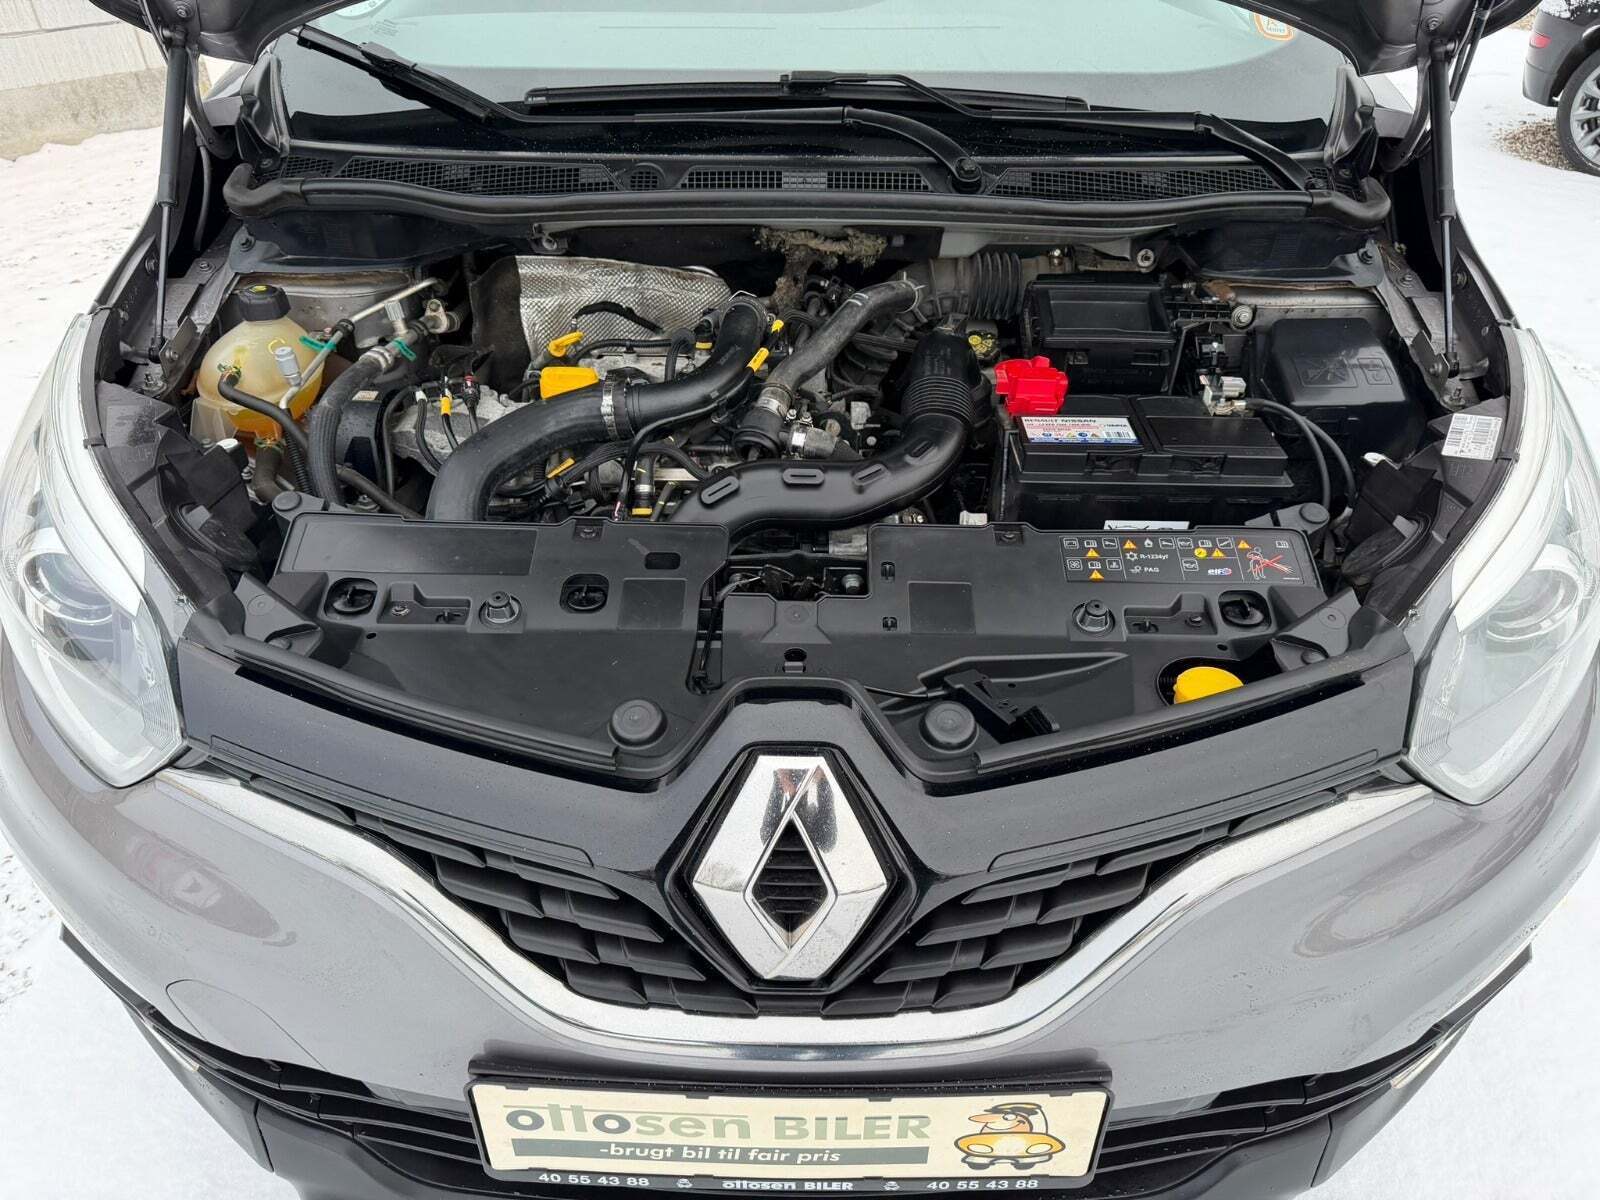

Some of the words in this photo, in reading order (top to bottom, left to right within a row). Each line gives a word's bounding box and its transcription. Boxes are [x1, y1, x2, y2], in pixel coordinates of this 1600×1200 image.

[774, 1115, 931, 1140] BILER
[600, 1143, 673, 1160] -brugt
[682, 1146, 711, 1160] bil
[718, 1148, 741, 1161] til
[748, 1149, 790, 1162] fair
[797, 1150, 841, 1164] pris
[539, 1173, 561, 1183] 40
[568, 1174, 591, 1184] 55
[597, 1175, 620, 1186] 43
[626, 1177, 649, 1187] 88
[804, 1181, 853, 1191] BILER
[926, 1181, 950, 1190] 40
[957, 1180, 980, 1190] 55
[986, 1180, 1009, 1189] 43
[1015, 1179, 1039, 1188] 88
